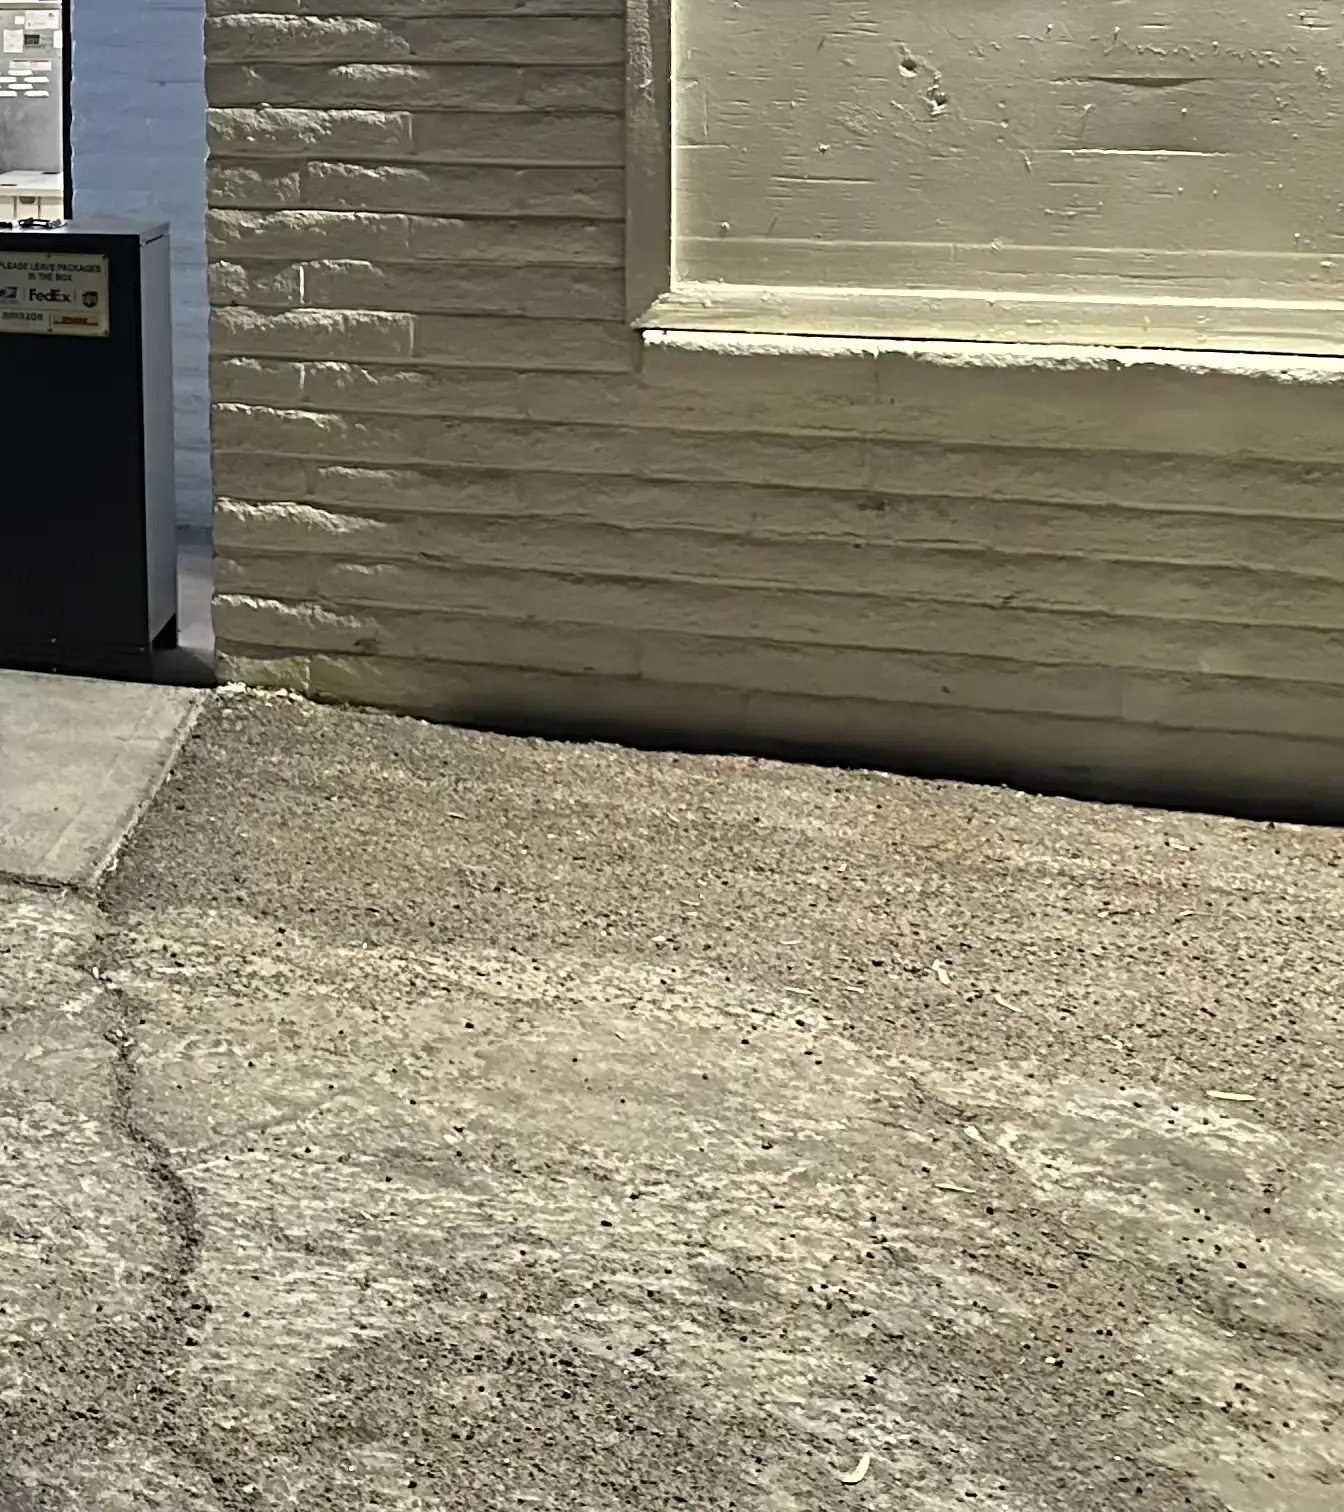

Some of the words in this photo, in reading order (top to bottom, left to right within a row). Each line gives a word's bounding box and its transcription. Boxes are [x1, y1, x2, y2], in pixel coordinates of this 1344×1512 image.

[30, 262, 55, 272] LEAVE
[57, 263, 102, 273] PACKAGES
[28, 272, 36, 281] IN
[38, 273, 53, 281] THE
[55, 273, 73, 282] BOX
[29, 288, 72, 302] FedEx
